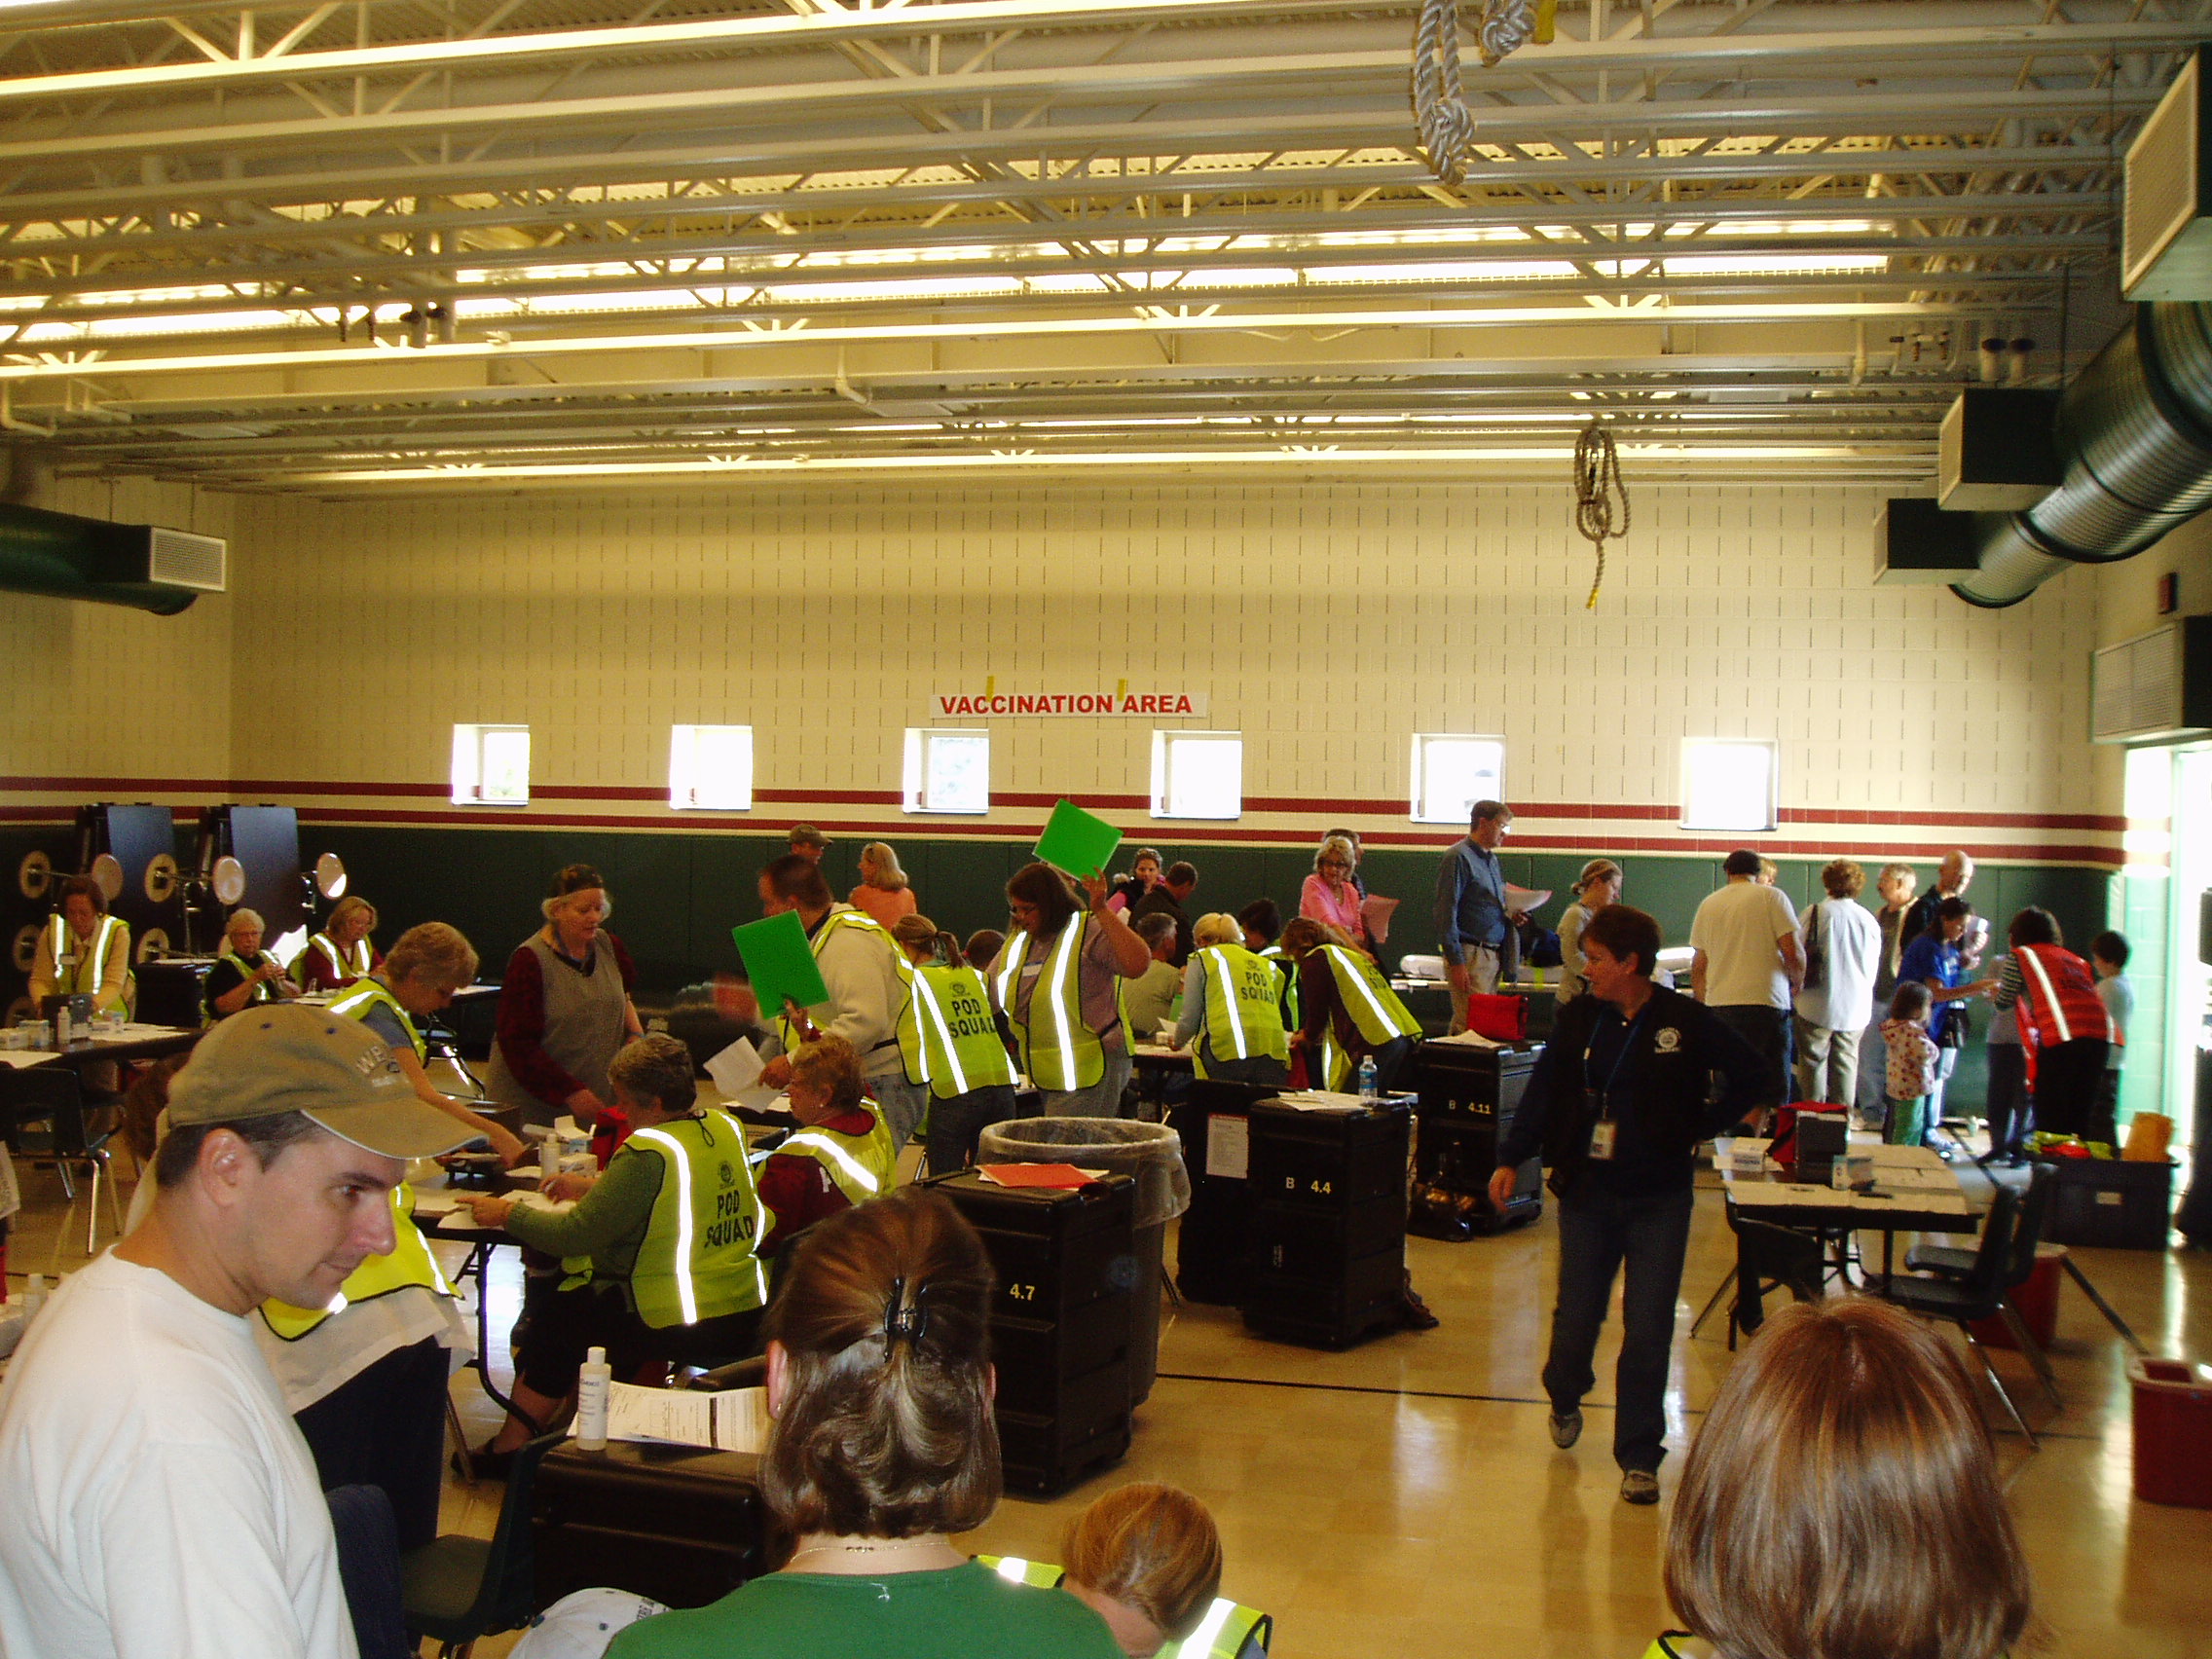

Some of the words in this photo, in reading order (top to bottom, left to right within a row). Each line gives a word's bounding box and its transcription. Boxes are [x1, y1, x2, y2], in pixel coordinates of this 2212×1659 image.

[940, 694, 1114, 715] VACCINATION
[1122, 694, 1193, 714] AREA
[951, 998, 981, 1017] POD
[1468, 1102, 1492, 1115] 4.11
[1285, 1176, 1295, 1189] B
[1310, 1180, 1332, 1195] 4.4
[717, 1189, 740, 1219] POD
[704, 1215, 756, 1249] SQUAD
[1010, 1283, 1035, 1301] 4.7
